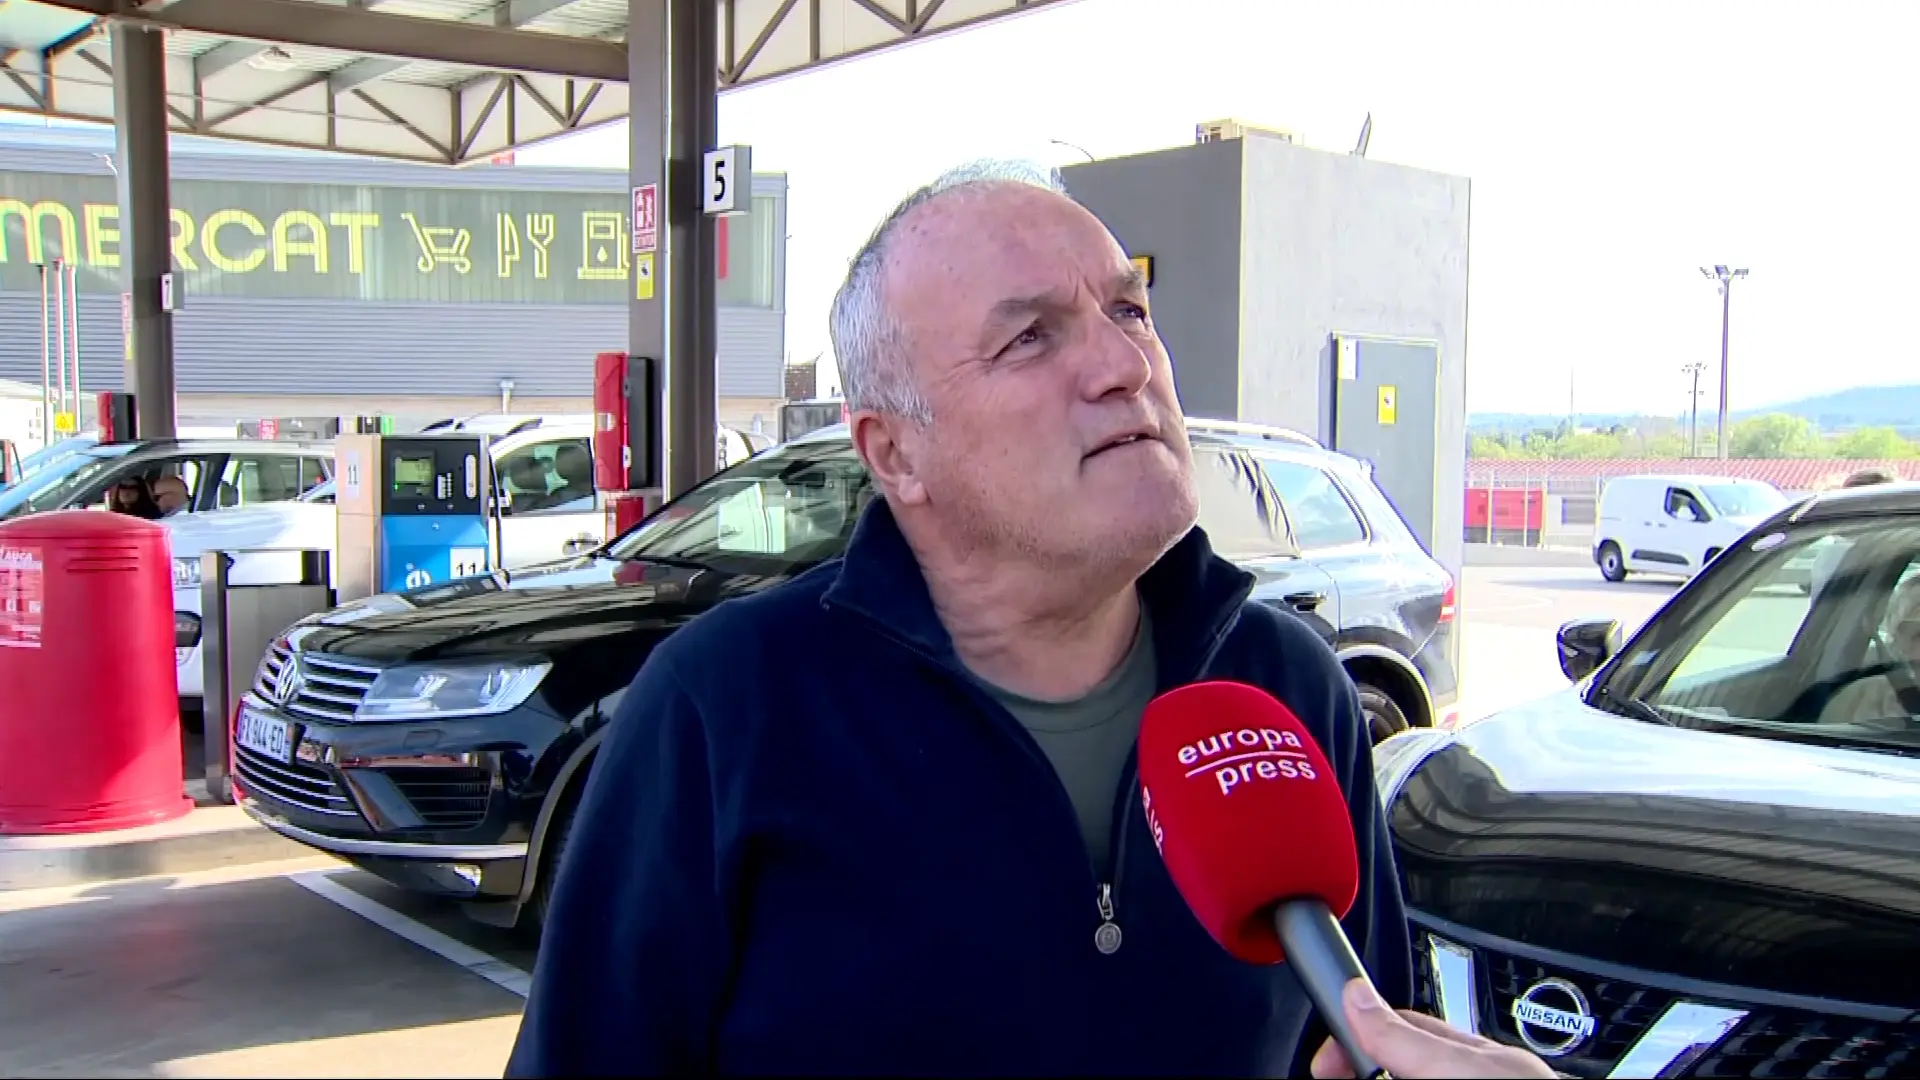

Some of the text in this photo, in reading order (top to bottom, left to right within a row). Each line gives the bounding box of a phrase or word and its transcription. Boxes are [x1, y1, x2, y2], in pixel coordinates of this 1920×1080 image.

[713, 160, 726, 202] 5
[456, 562, 476, 576] 11
[1177, 728, 1303, 765] europa
[1215, 758, 1317, 796] press
[1516, 1003, 1581, 1030] NISSAN
